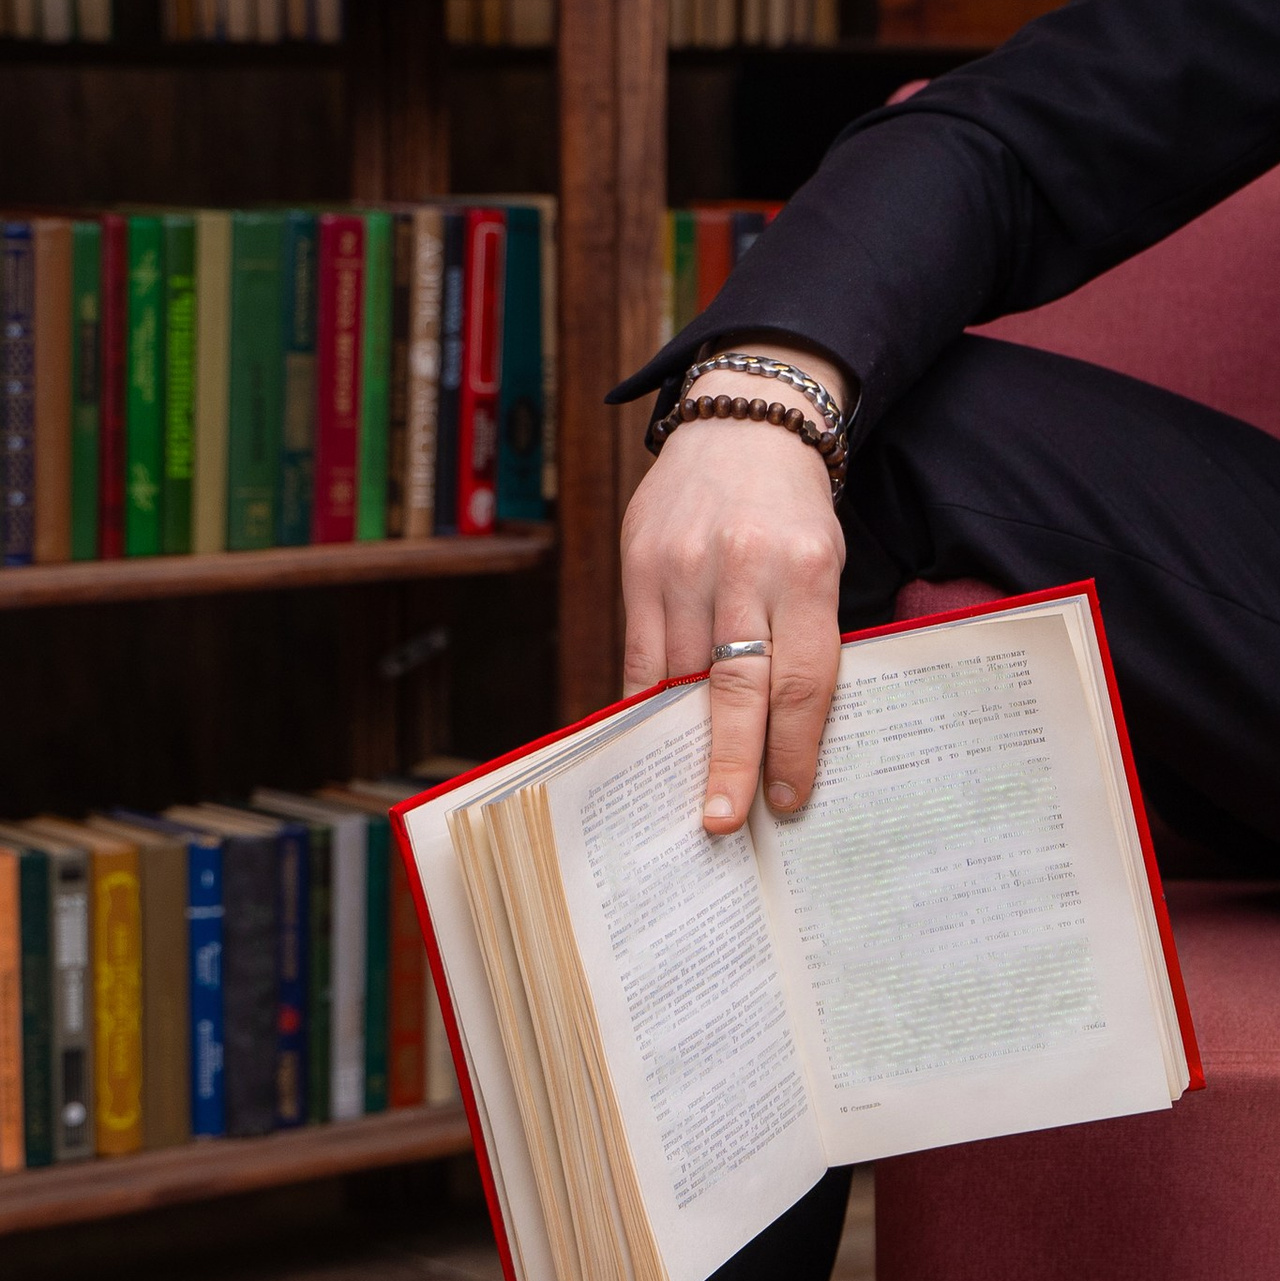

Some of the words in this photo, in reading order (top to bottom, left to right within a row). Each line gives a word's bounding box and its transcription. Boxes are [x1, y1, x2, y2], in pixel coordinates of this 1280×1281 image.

[835, 681, 852, 690] как
[854, 674, 877, 688] факт
[880, 670, 898, 681] был
[902, 660, 953, 678] установлен,
[956, 655, 981, 667] юный
[984, 648, 1026, 663] дипломат
[986, 657, 1028, 673] Жюльену
[838, 713, 849, 721] он
[852, 710, 863, 718] за
[885, 701, 908, 711] свою
[1017, 677, 1033, 688] раз
[888, 719, 923, 731] сказали
[928, 713, 945, 722] они
[981, 701, 1003, 713] Ведь
[1008, 697, 1037, 708] только
[856, 736, 879, 748] Надо
[938, 719, 965, 731] чтобы
[967, 711, 1000, 727] первый
[1003, 709, 1021, 719] ваш
[1023, 706, 1039, 716] вы-
[853, 756, 931, 779] пользовавшемуся
[965, 744, 992, 757] время
[997, 734, 1046, 752] громадным
[879, 749, 916, 764] Бовуази
[1017, 847, 1033, 857] это
[1000, 882, 1011, 891] из
[1059, 897, 1082, 908] этого
[983, 929, 1009, 942] чтобы
[1056, 918, 1071, 928] что
[1073, 916, 1085, 925] он
[833, 1080, 849, 1089] они
[839, 1106, 848, 1115] 10
